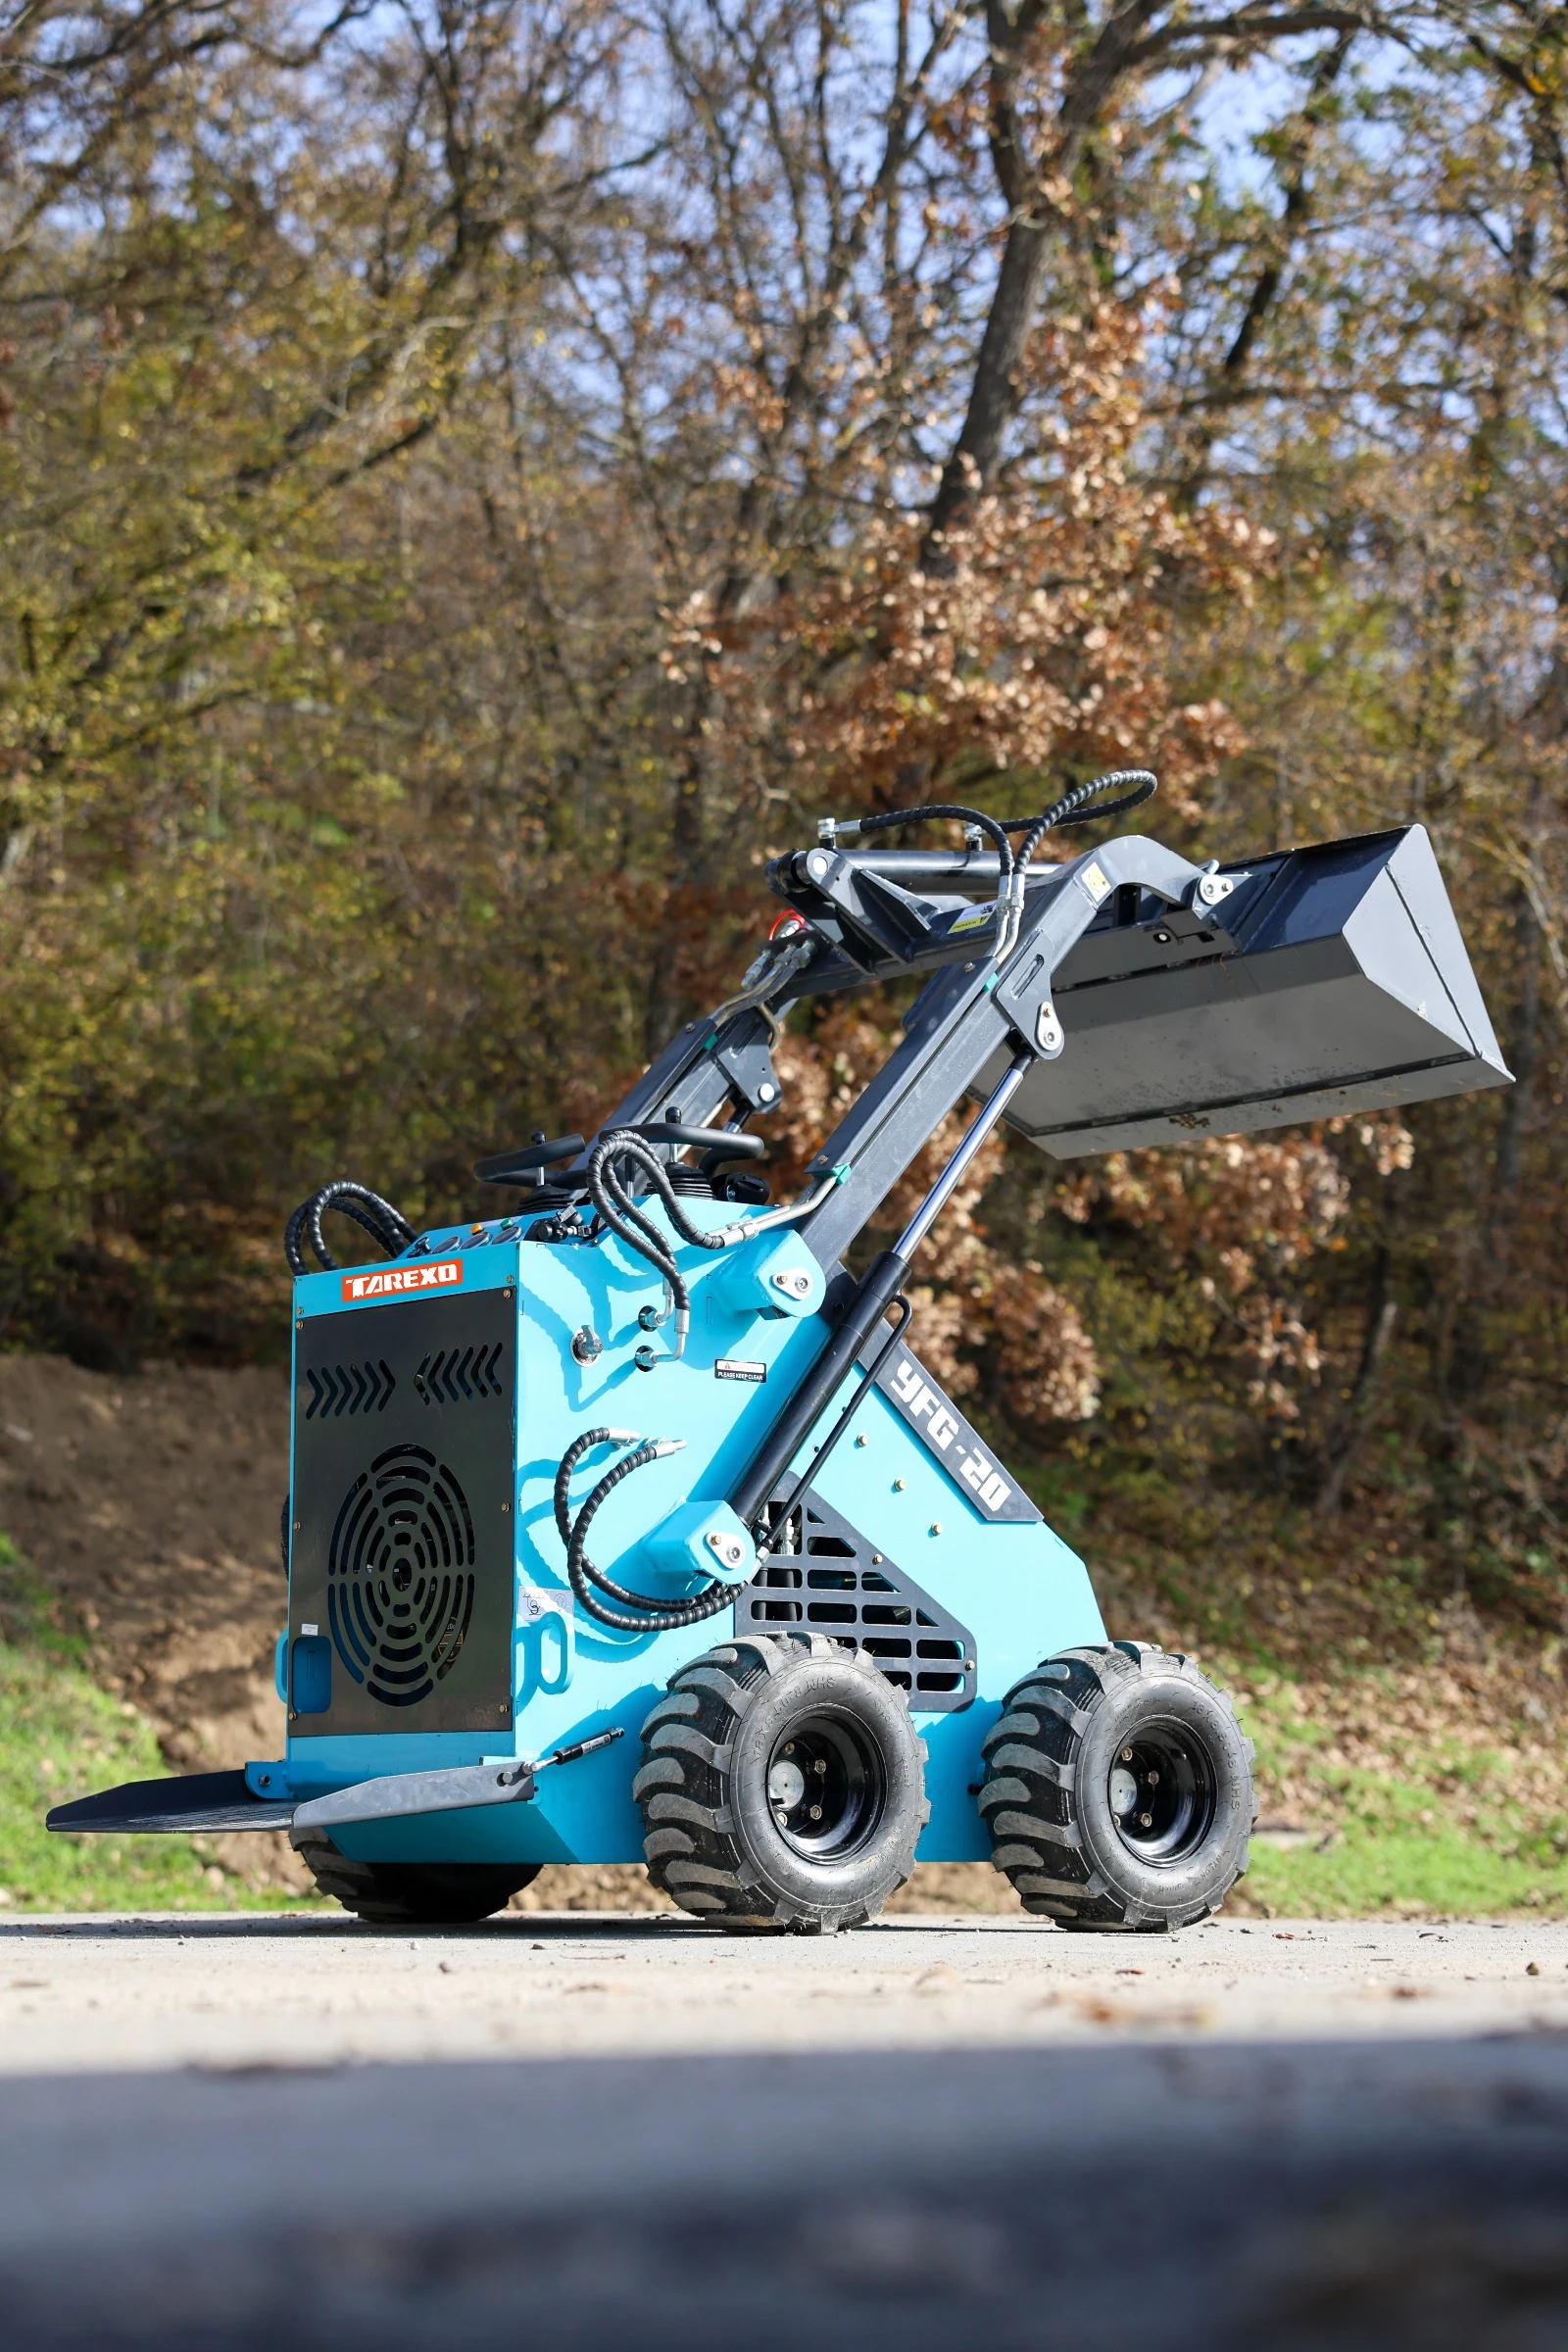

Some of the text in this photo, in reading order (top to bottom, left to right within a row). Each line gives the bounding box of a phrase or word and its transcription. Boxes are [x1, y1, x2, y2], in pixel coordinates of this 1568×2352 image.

[346, 1264, 458, 1298] TAREXO
[890, 1358, 1011, 1512] YFG-20
[806, 1676, 836, 1690] NHS
[1230, 1775, 1243, 1811] NHS
